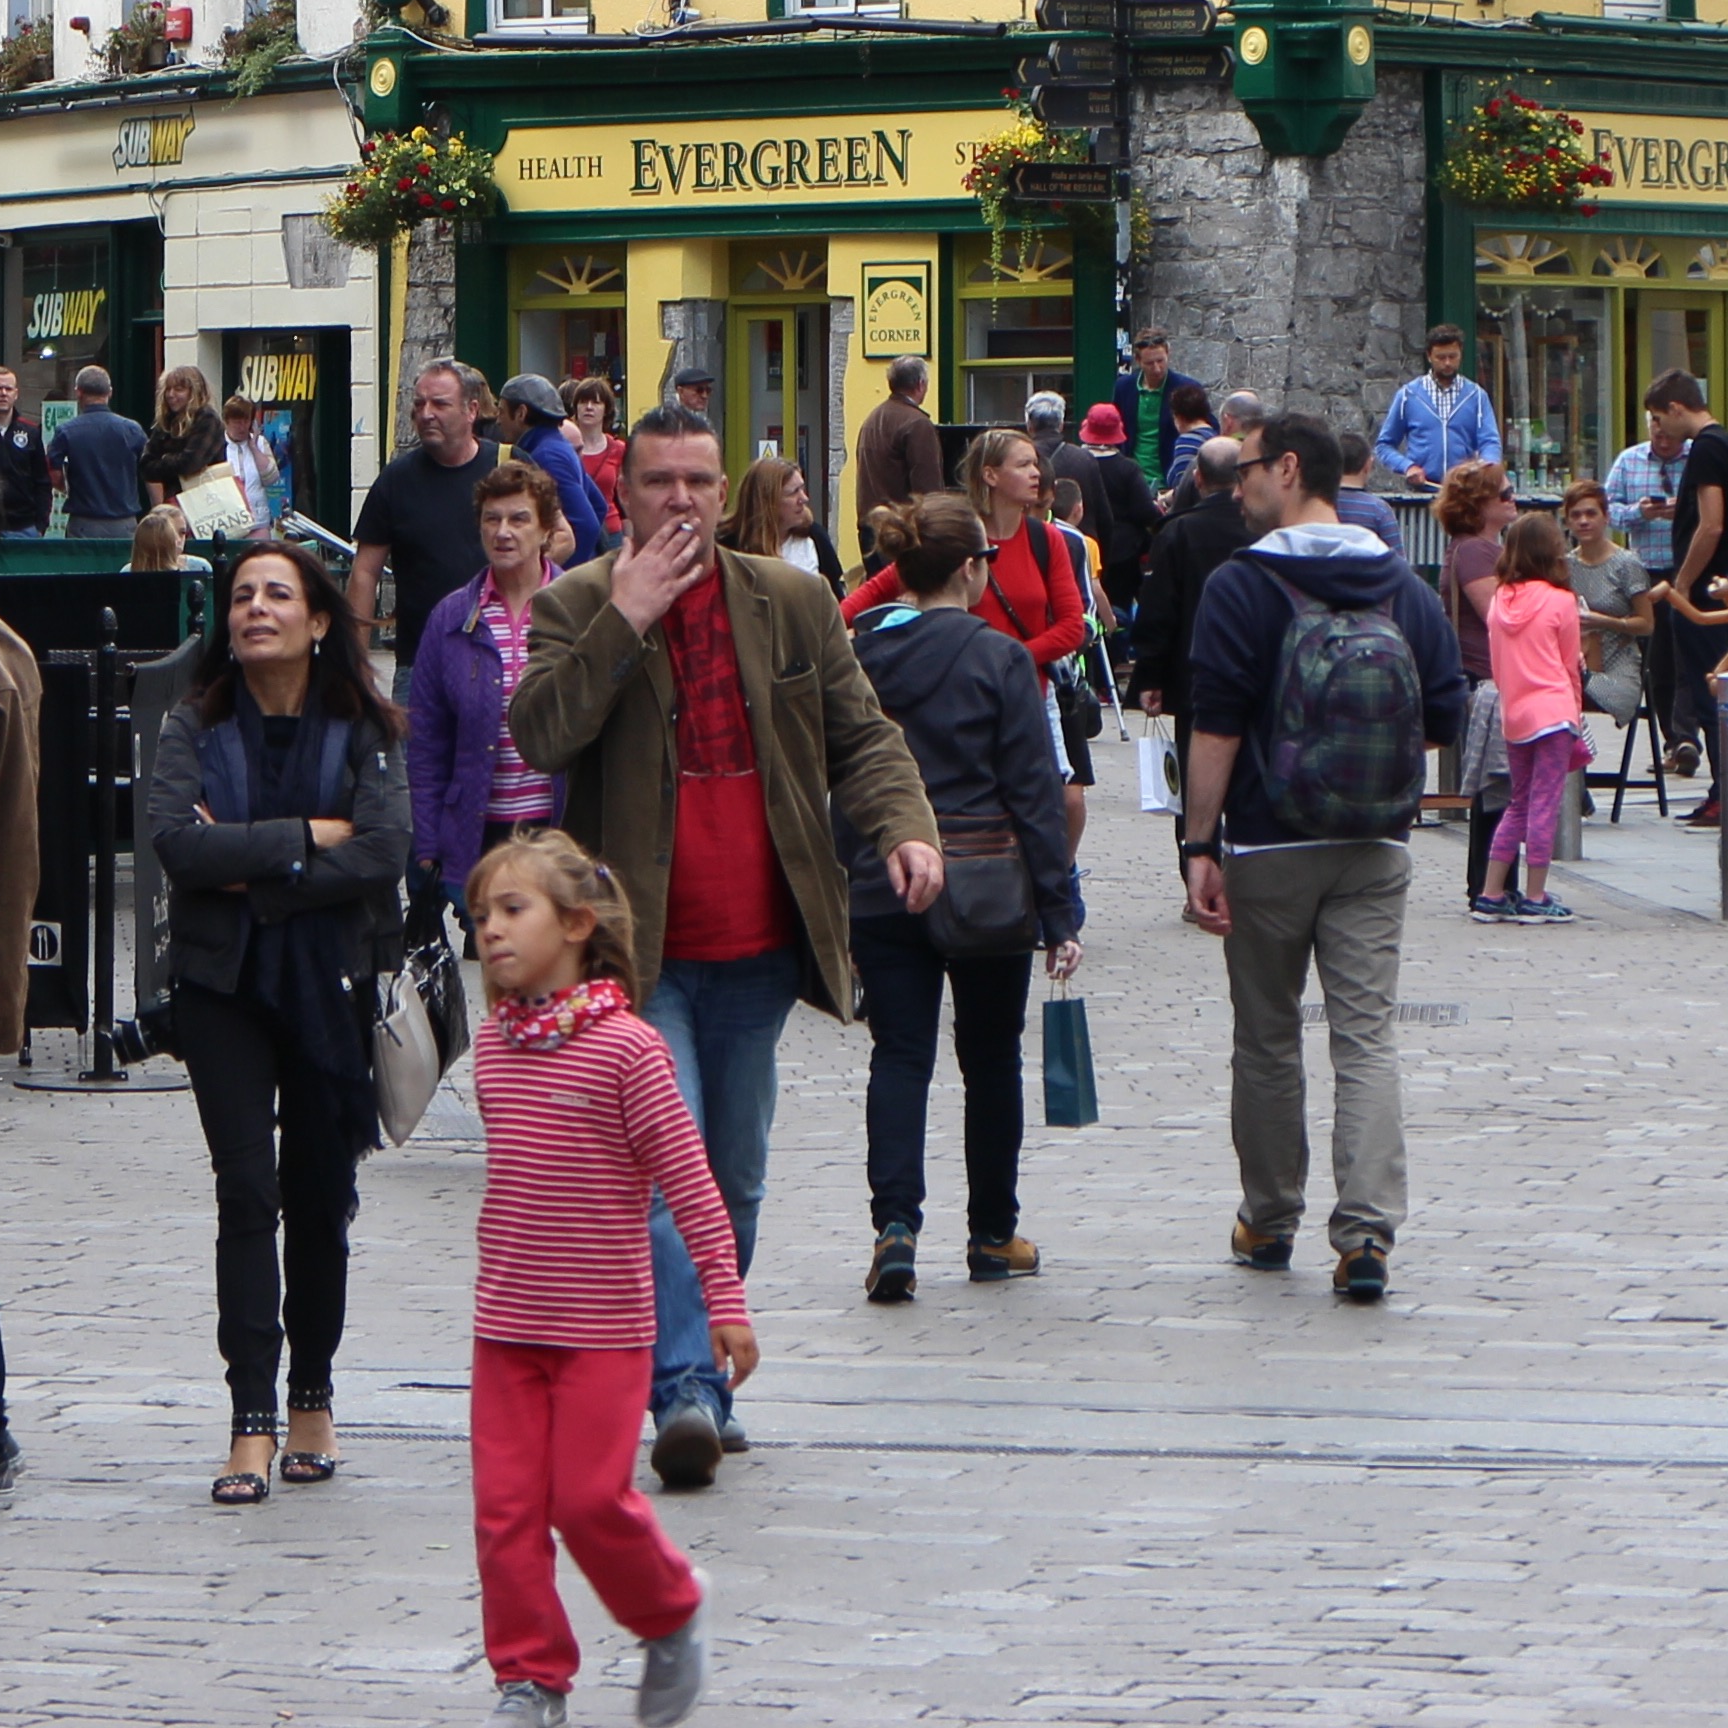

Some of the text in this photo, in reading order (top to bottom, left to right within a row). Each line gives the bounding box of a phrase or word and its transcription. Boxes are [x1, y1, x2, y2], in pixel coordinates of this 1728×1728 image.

[1172, 66, 1206, 76] WINDOW
[112, 107, 196, 175] SUBWAY
[518, 154, 604, 182] HEALTH
[629, 128, 913, 196] EVERGREEN
[1030, 183, 1048, 193] HALL
[27, 285, 107, 342] SUBWAY
[868, 289, 923, 323] EVERGREEN
[869, 329, 921, 343] CORNER
[237, 354, 318, 404] SUBWAY
